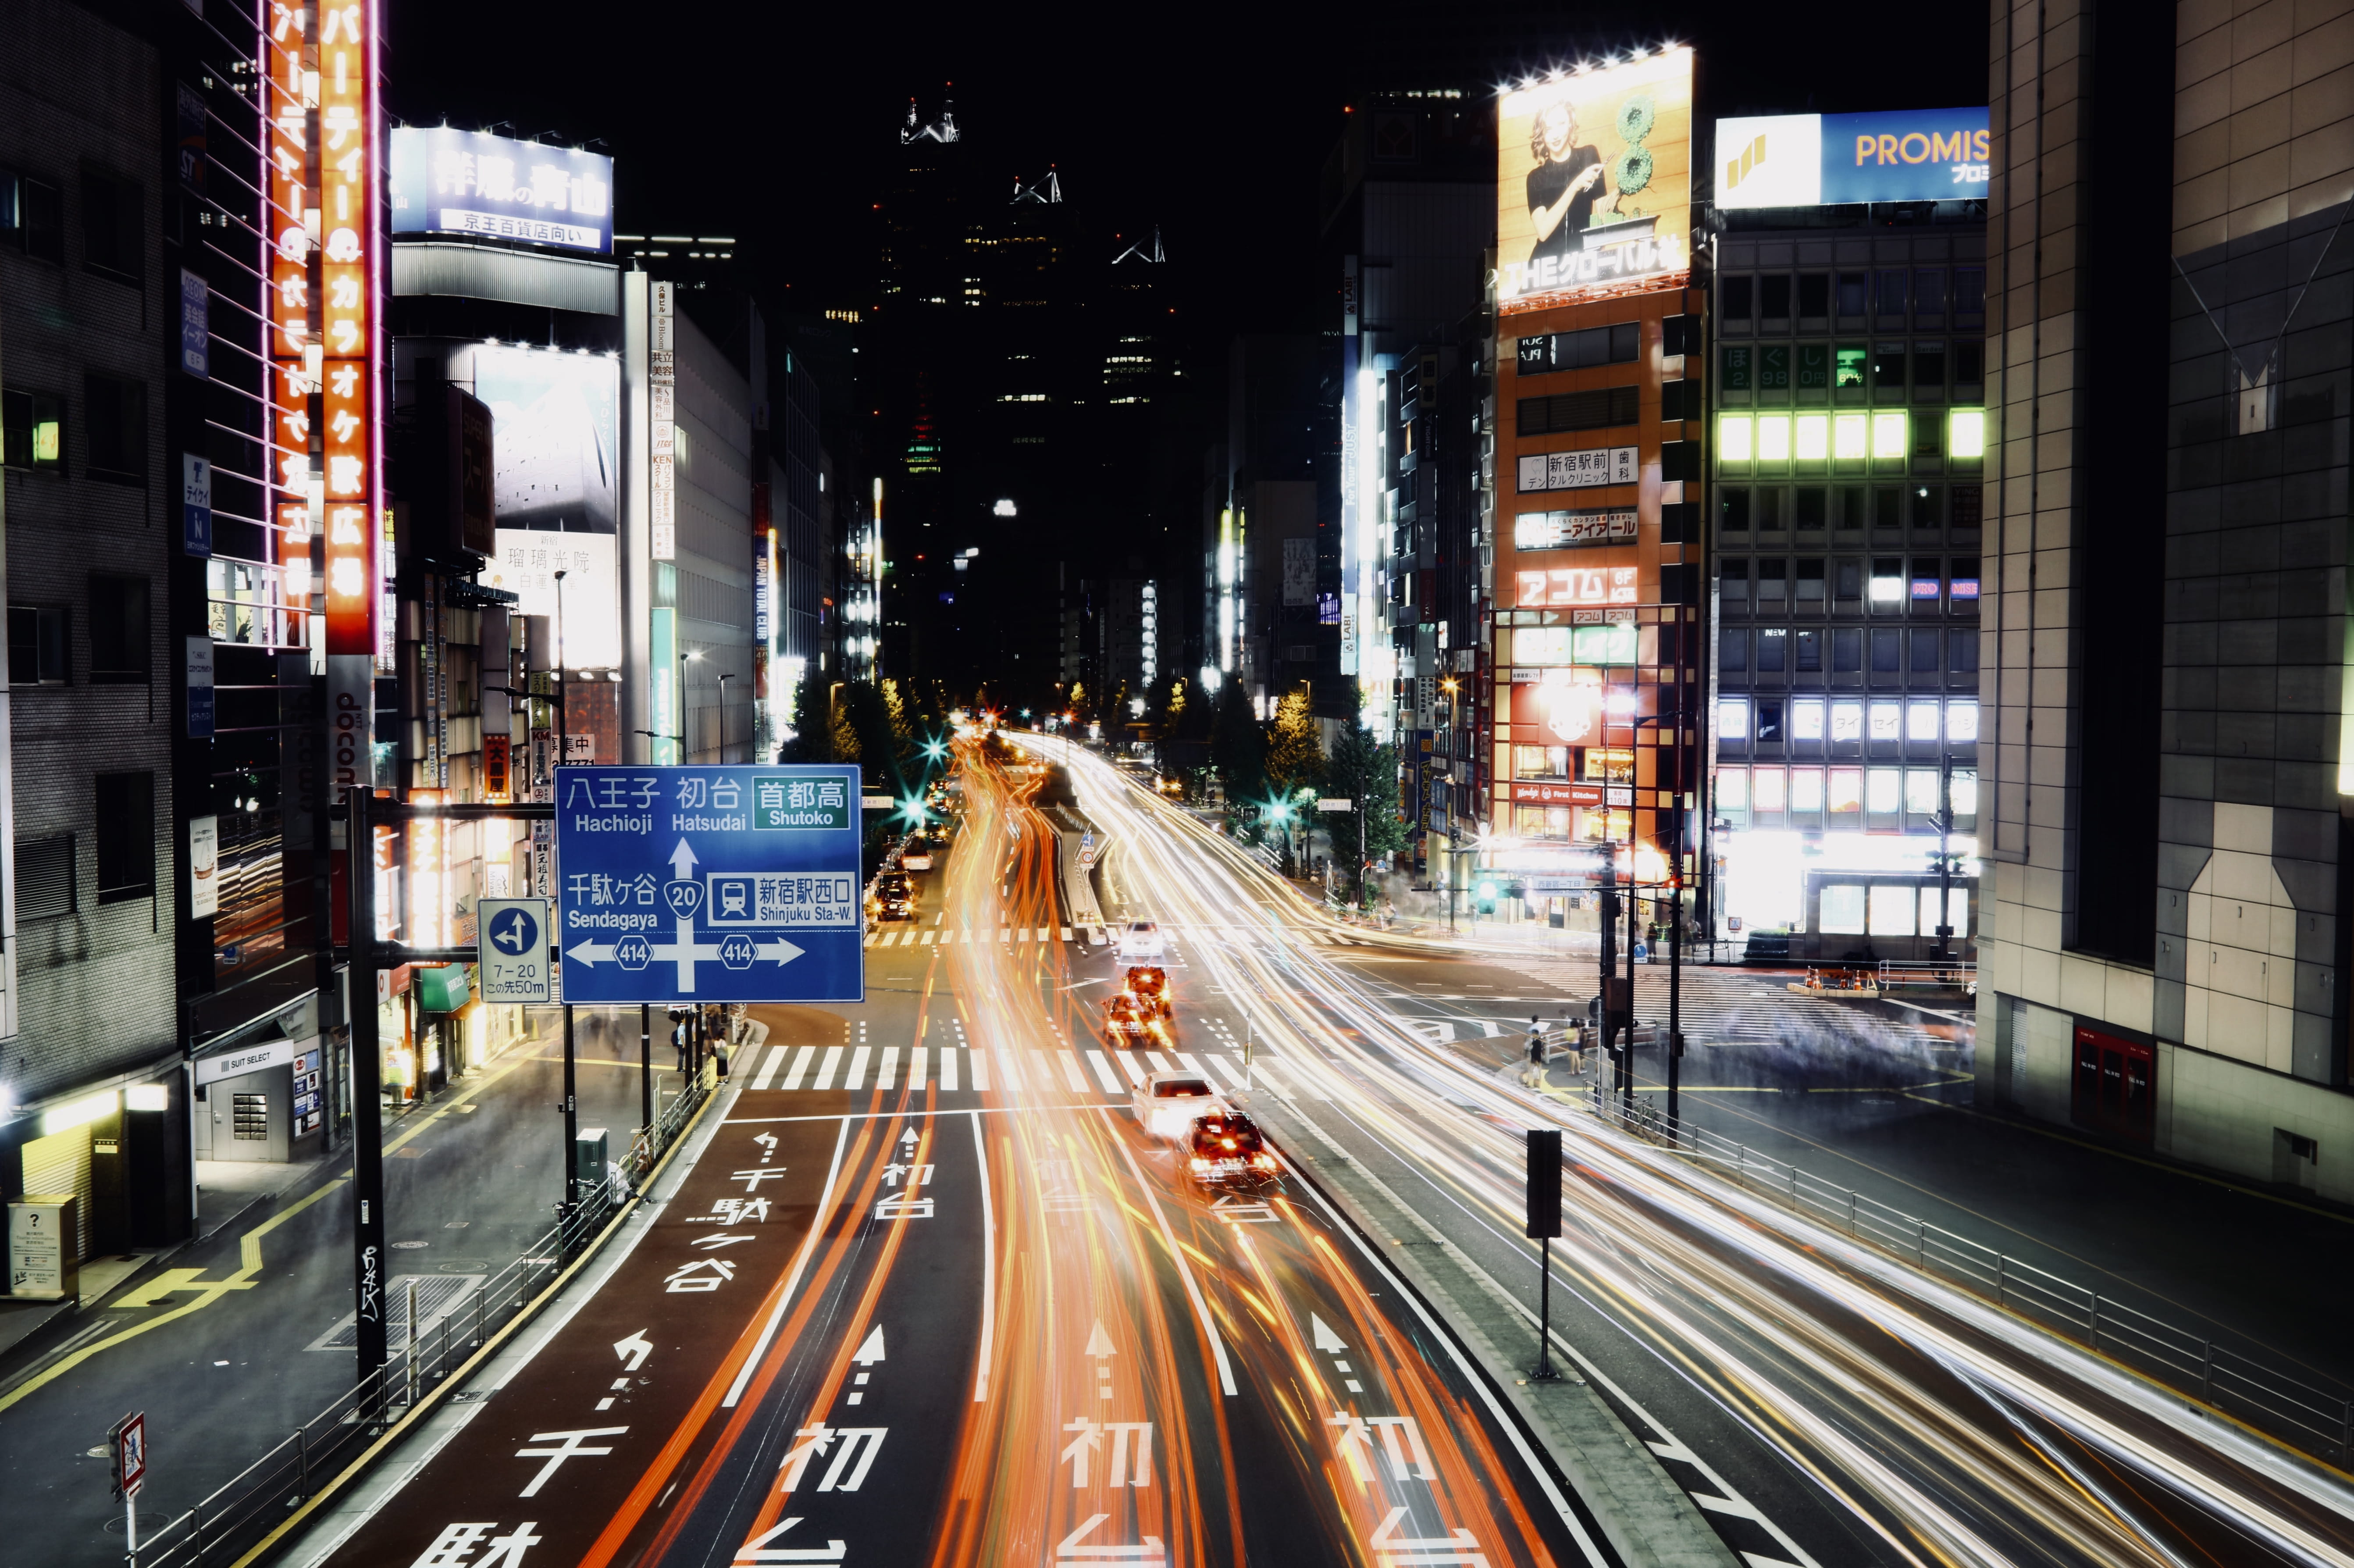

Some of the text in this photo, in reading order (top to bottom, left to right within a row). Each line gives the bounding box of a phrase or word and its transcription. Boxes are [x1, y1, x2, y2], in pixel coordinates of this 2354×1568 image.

[1856, 130, 1989, 166] PROMIS
[435, 150, 607, 217] 洋服の青山
[1952, 163, 1989, 183] プロミ
[463, 214, 582, 243] 京王百貨店向い
[1504, 234, 1681, 289] THEグローバル社
[185, 276, 205, 306] AEON
[185, 303, 205, 329] 英会話
[182, 324, 207, 349] イーオン
[652, 353, 672, 363] 共立
[652, 366, 673, 376] 美容
[1345, 424, 1357, 459] JUST
[1549, 453, 1606, 473] 新宿駅前
[1619, 450, 1629, 480] 歯科
[1528, 471, 1609, 488] デンタルクリニック
[1345, 489, 1355, 506] For
[540, 535, 558, 546] 新宿
[1550, 521, 1636, 539] エーアイアール
[508, 548, 589, 570] 瑠璃光院
[1522, 571, 1604, 603] アコム
[1615, 571, 1632, 584] 6F
[1912, 583, 1937, 594] PRO
[756, 556, 767, 640] JAPAN TOTAL CLUB
[1577, 612, 1600, 621] アコム
[1608, 611, 1632, 620] アコム
[1574, 632, 1629, 657] レイク
[533, 731, 550, 741] KM
[336, 692, 362, 804] docom
[489, 746, 504, 792] 大黒屋
[1421, 760, 1432, 801] マツモト
[566, 777, 844, 809] 八王子 初台 首都高
[1517, 788, 1538, 798] Wendy's
[576, 811, 833, 835] Hachioji Hatsudai Shutoko
[1421, 803, 1432, 832] キヨシ
[537, 853, 548, 895] 元祖寿司
[568, 873, 851, 906] 千駄ヶ谷 新宿駅西口
[673, 887, 696, 906] 20
[569, 907, 851, 930] Sendagaya Shinjuku Sta.-W.
[620, 946, 647, 960] 414
[724, 944, 751, 959] 414
[494, 965, 535, 978] 7-20
[487, 980, 544, 994] この先50m
[231, 1052, 271, 1069] SUIT SELECT
[876, 1163, 934, 1219] 初台
[665, 1167, 787, 1293] 千駄ヶ谷
